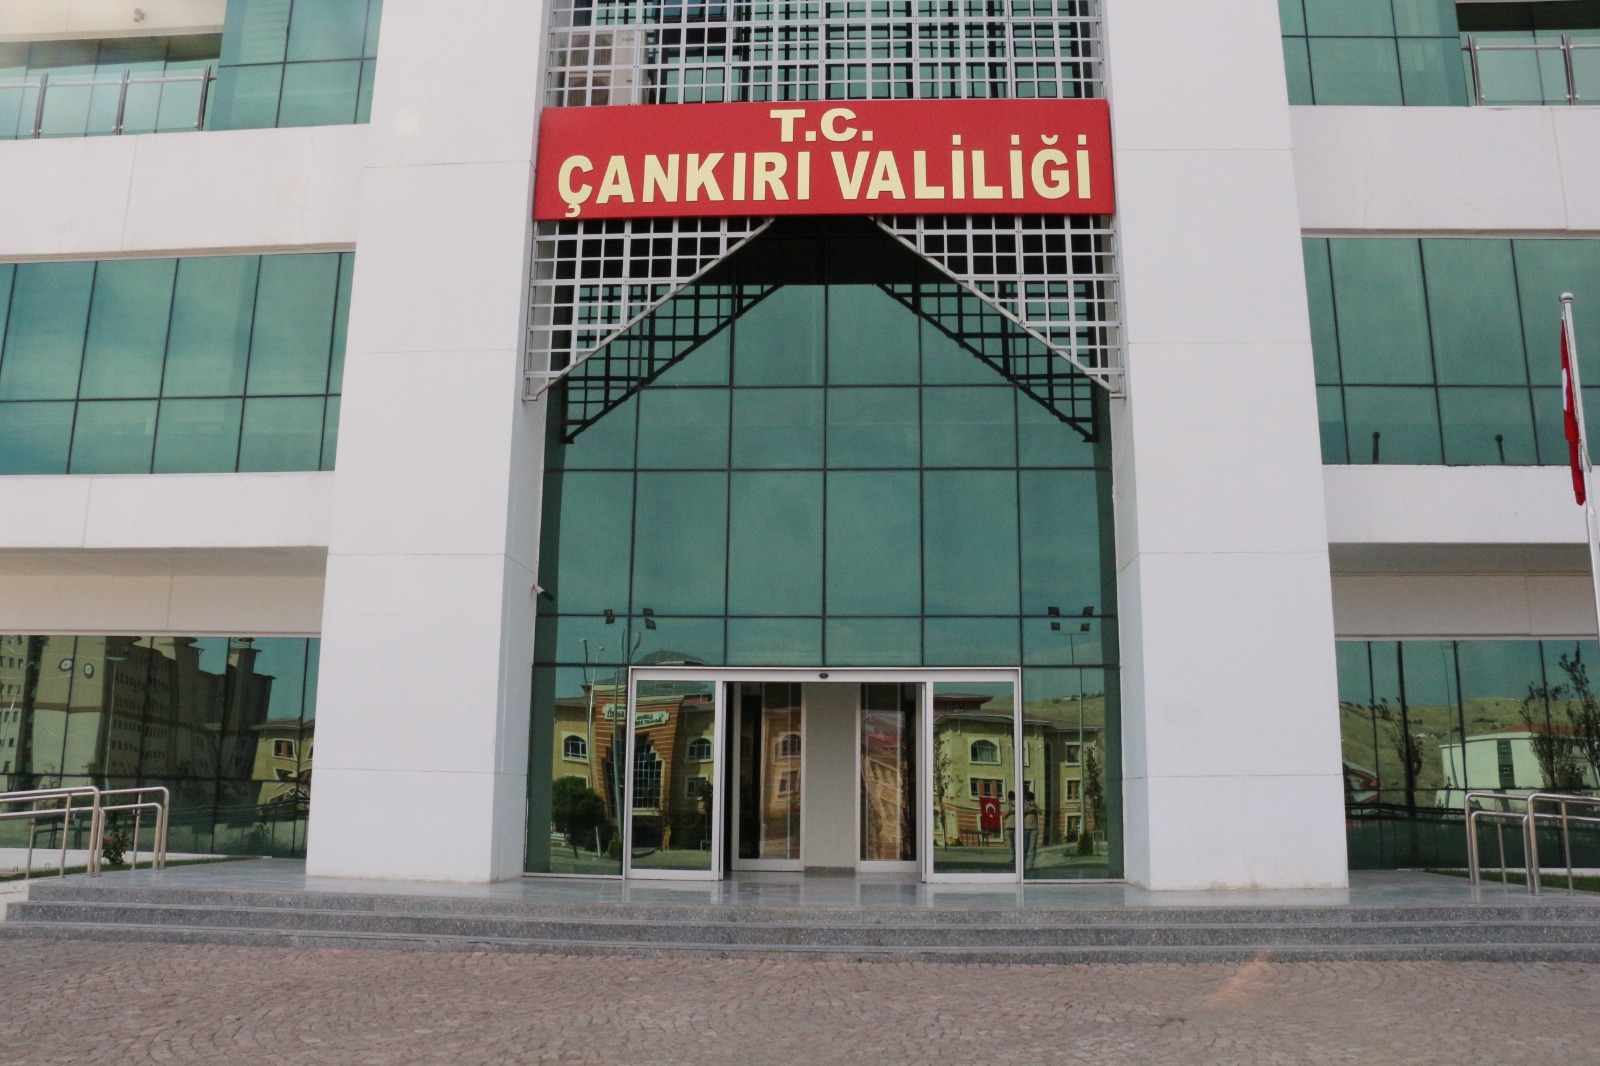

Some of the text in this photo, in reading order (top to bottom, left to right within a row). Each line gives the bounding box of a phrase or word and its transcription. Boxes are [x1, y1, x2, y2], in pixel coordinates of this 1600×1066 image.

[770, 108, 874, 143] T.C.
[557, 134, 1091, 218] ÇANKIRI VALİLİĞİ
